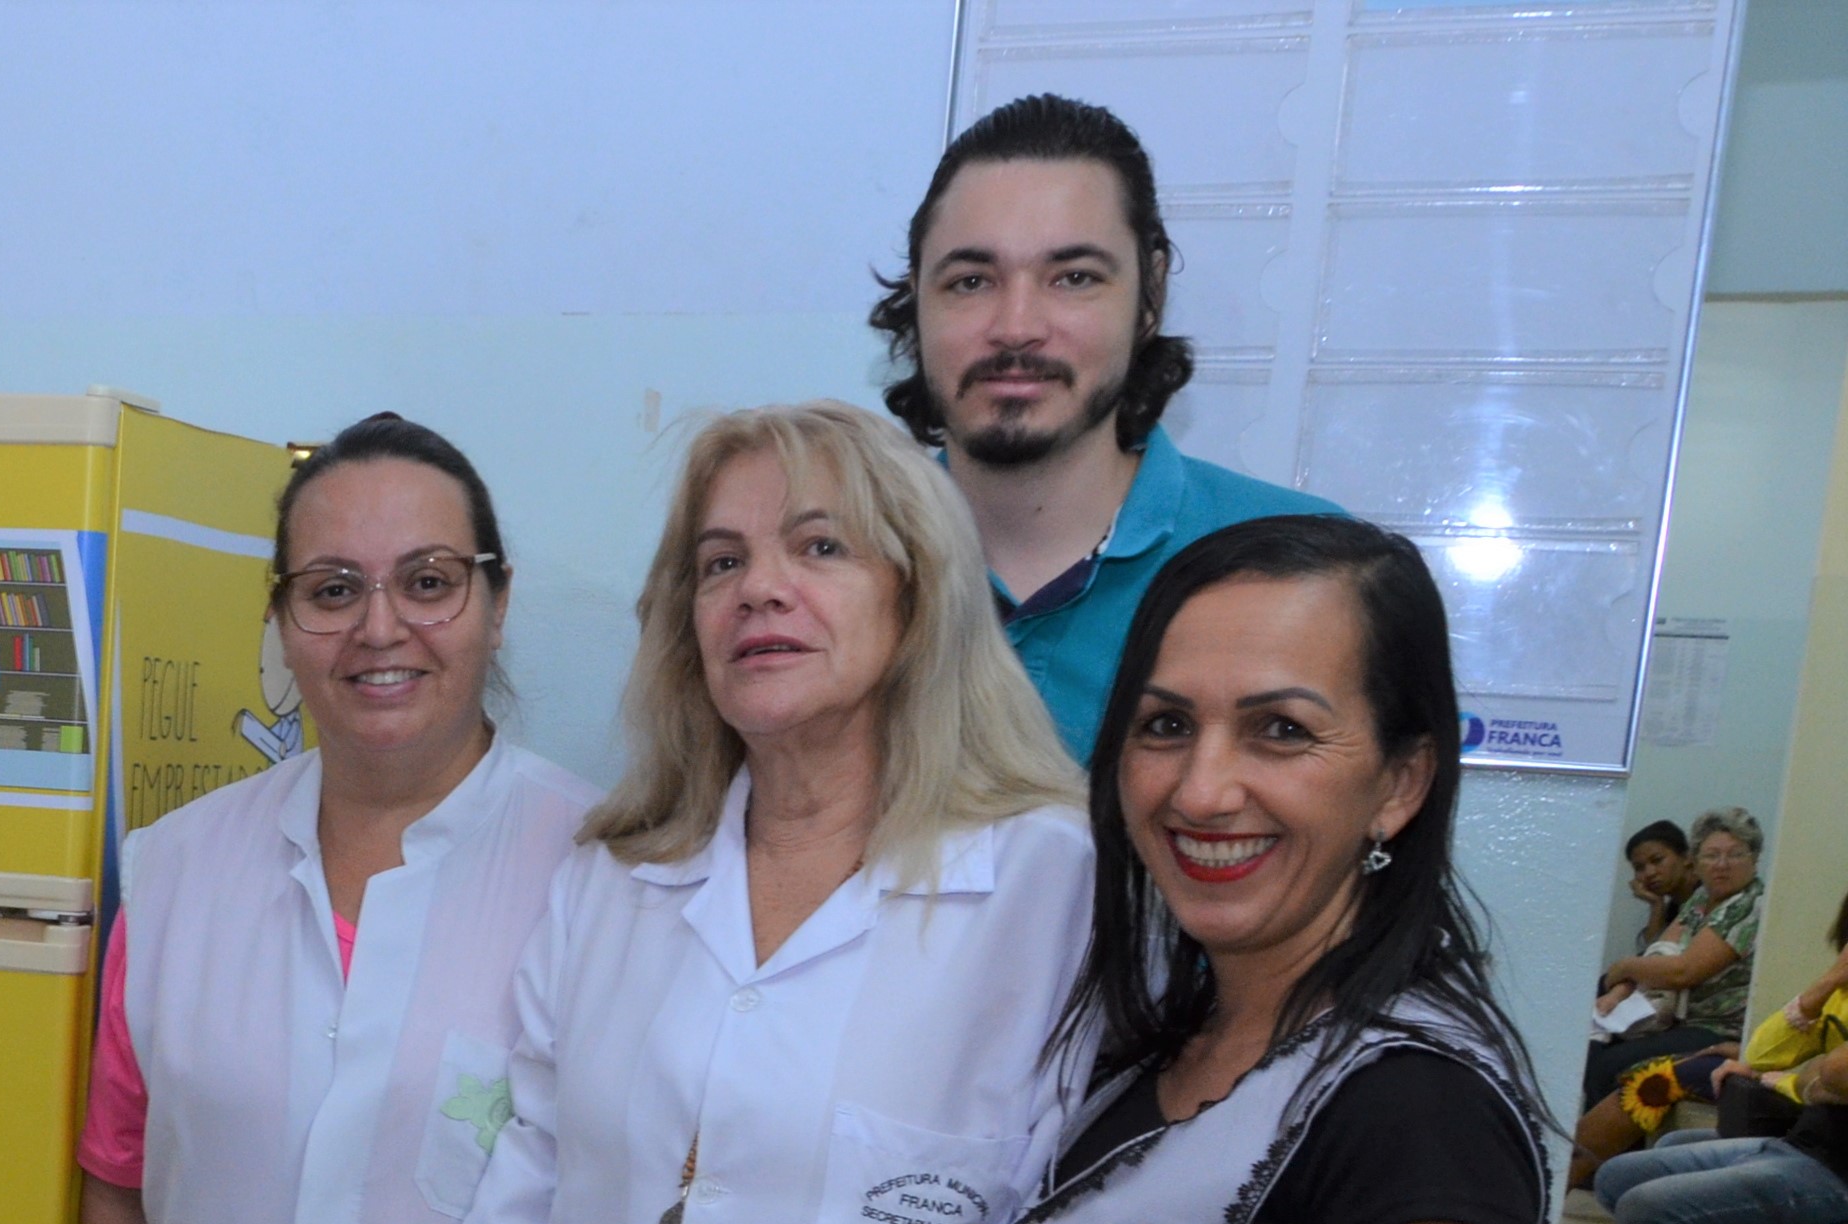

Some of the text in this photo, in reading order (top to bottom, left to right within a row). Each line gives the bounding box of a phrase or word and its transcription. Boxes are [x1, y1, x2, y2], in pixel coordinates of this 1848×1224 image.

[140, 656, 201, 742] PEGUE
[1490, 718, 1558, 731] PREFEITURA
[1487, 730, 1563, 748] FRANCA
[866, 1173, 941, 1201] PREFEITURA
[899, 1193, 963, 1217] FRANCA
